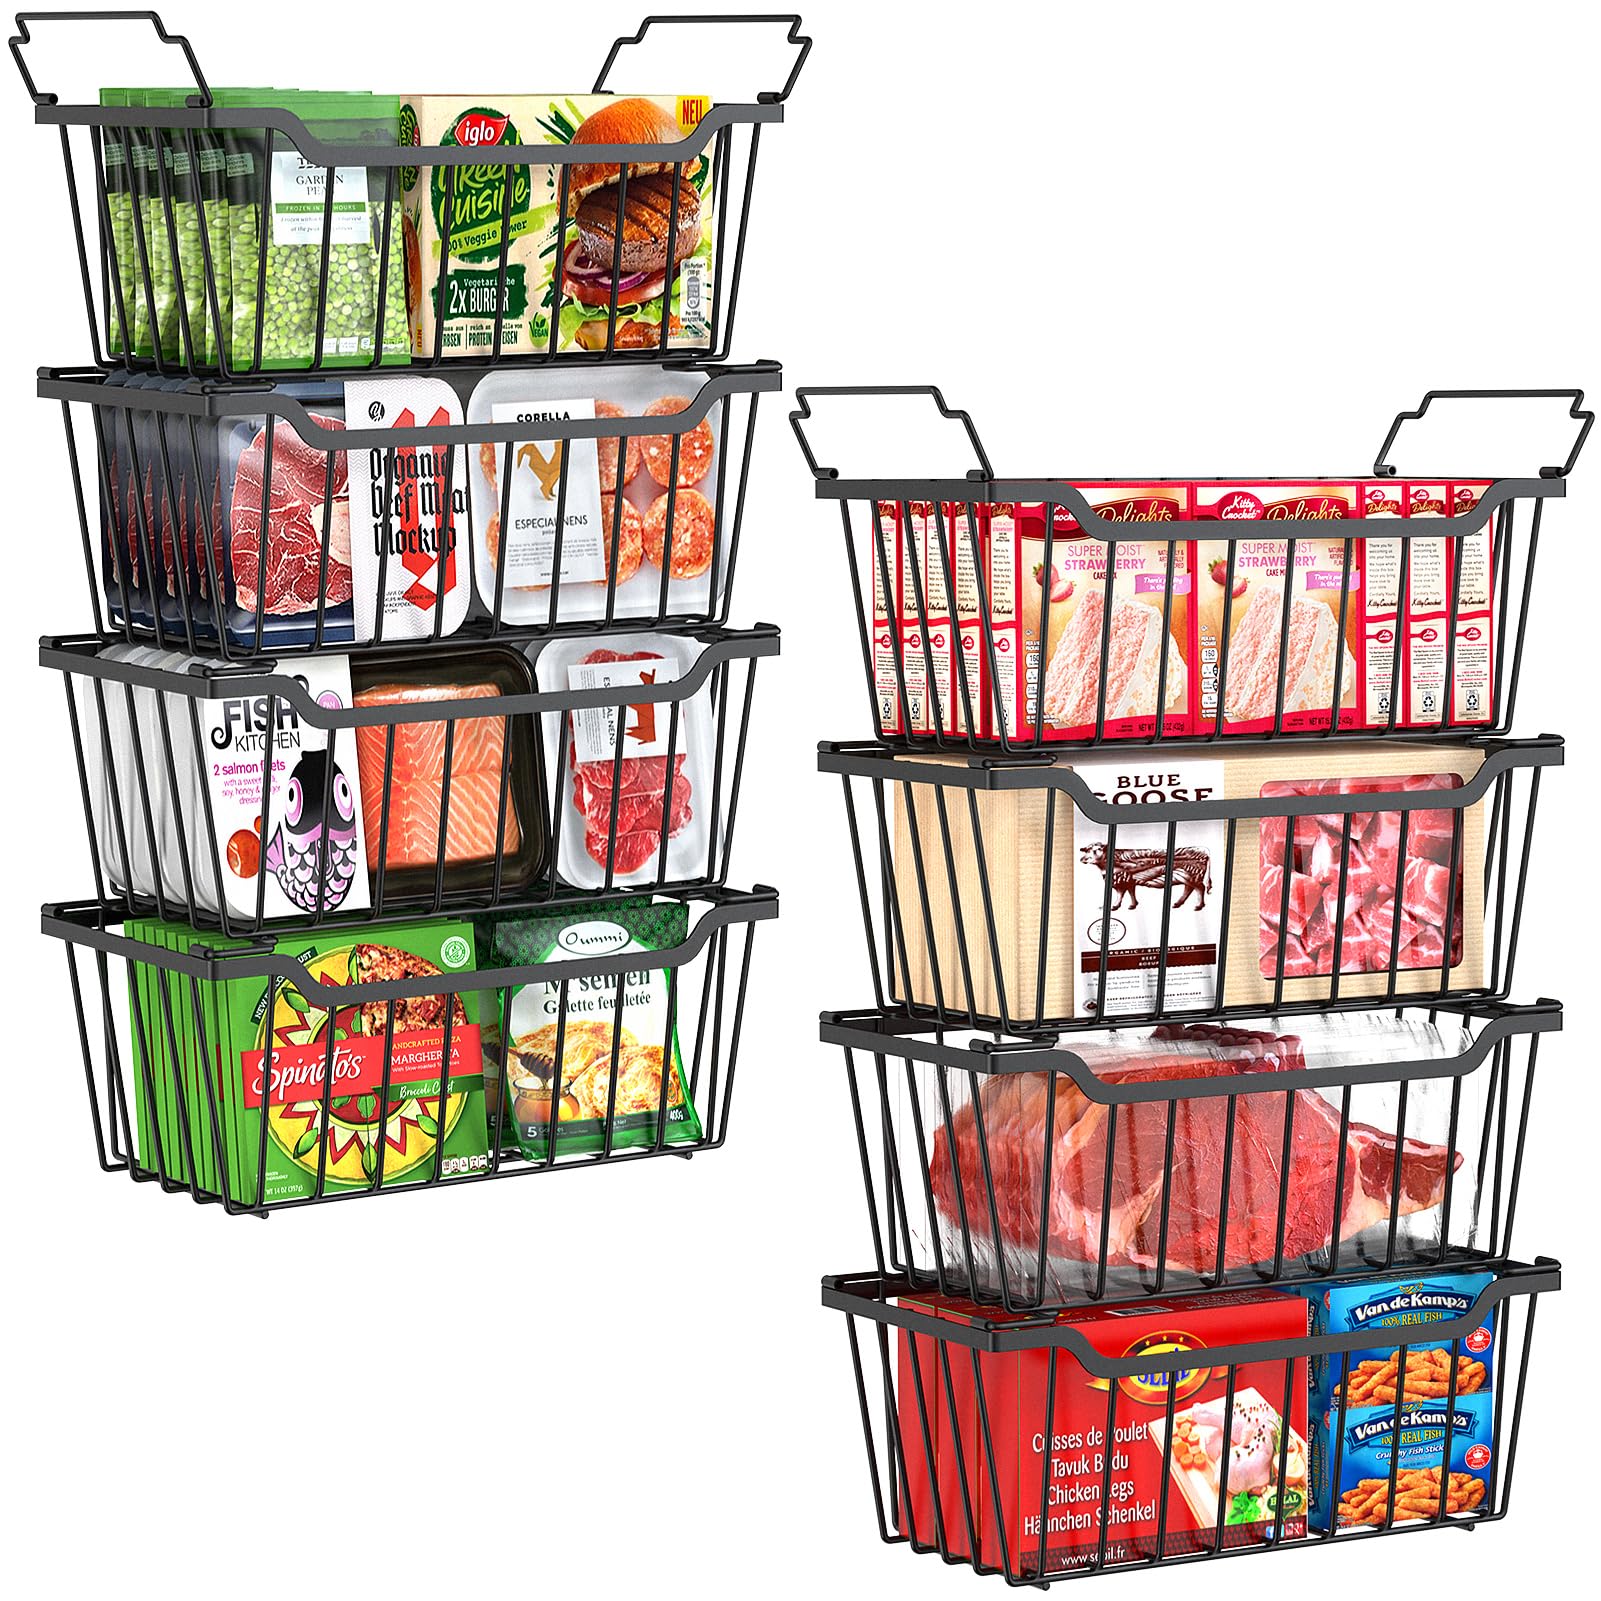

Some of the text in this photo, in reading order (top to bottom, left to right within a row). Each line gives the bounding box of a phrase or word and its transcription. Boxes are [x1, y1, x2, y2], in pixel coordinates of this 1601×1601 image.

[683, 101, 703, 125] NEU
[464, 120, 494, 147] iglo
[464, 229, 497, 247] Veggie
[501, 223, 527, 241] ower
[464, 277, 515, 288] Vegetarihe
[470, 286, 509, 313] BURGR
[529, 320, 549, 338] VEGAN
[442, 333, 461, 347] RBSEN
[469, 332, 493, 347] PROTEIN
[516, 411, 571, 423] CORELLA
[370, 481, 413, 524] bef
[1230, 495, 1256, 510] Kitty
[1267, 499, 1343, 520] Delights
[1221, 507, 1257, 520] Crochet
[1068, 544, 1142, 556] SUPER OIST
[1242, 543, 1276, 554] SUPER
[1064, 559, 1147, 571] STRAWERRY
[1238, 556, 1317, 568] STRAWBRRY
[1266, 569, 1279, 577] CAKE
[211, 697, 299, 750] FISH
[213, 763, 220, 776] 2
[222, 761, 258, 776] salmon
[1117, 774, 1181, 789] BLUE
[235, 786, 254, 797] honey
[239, 795, 265, 805] dressin
[565, 931, 623, 946] Oummi
[543, 998, 594, 1014] Glette
[389, 1038, 440, 1050] ANDCRAFTED
[391, 1048, 460, 1066] MARGHERA
[400, 1080, 455, 1099] Broccoli Cst
[527, 1126, 538, 1137] 5
[1381, 1311, 1443, 1327] 100% REAL FISH
[1087, 1426, 1103, 1446] de
[1113, 1420, 1148, 1443] oulet
[1381, 1428, 1442, 1445] 100 REAL FISH
[1408, 1446, 1424, 1455] Fish
[1425, 1444, 1445, 1453] Stick
[1051, 1450, 1129, 1478] Tavuk Bdu
[1048, 1480, 1135, 1506] Chicken egs
[1270, 1494, 1299, 1506] HLAL
